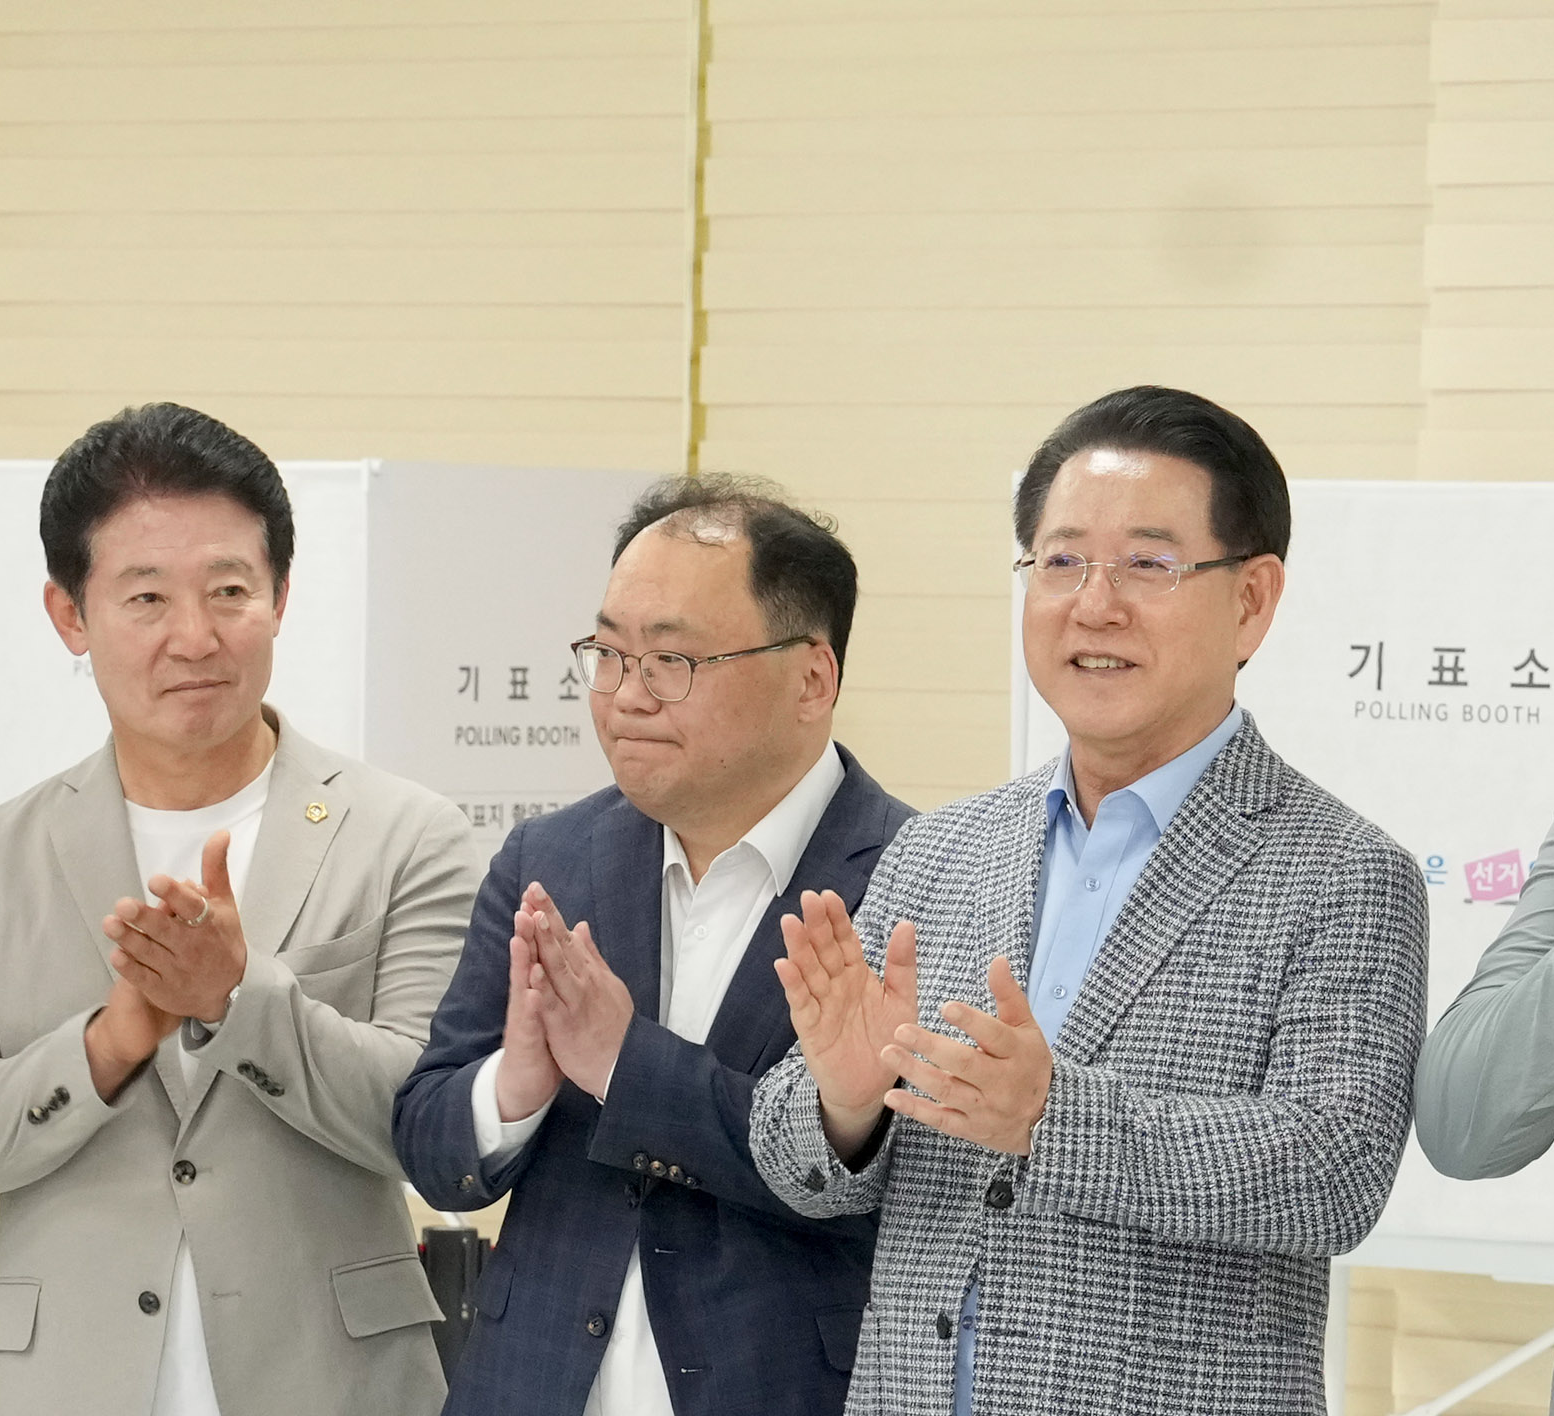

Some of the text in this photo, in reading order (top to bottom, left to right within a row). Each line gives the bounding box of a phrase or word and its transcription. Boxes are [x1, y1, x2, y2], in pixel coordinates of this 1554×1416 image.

[1354, 700, 1541, 724] POLLING BOOTH
[455, 725, 581, 746] POLLING BOOTH
